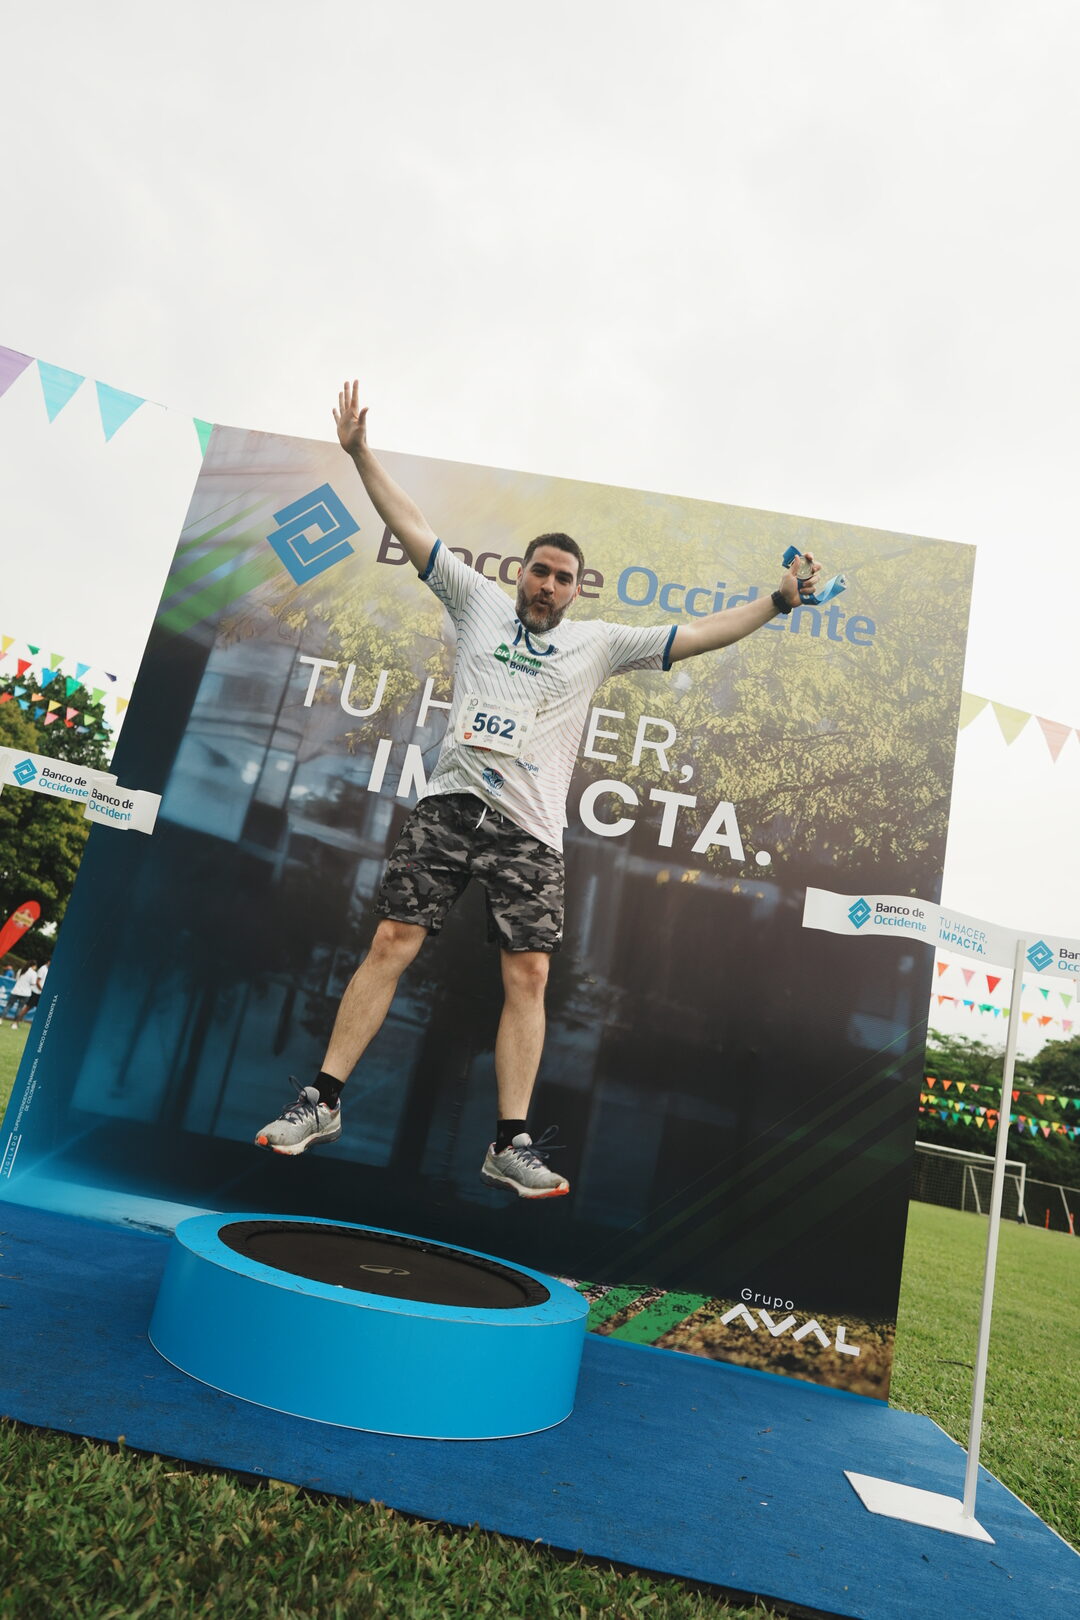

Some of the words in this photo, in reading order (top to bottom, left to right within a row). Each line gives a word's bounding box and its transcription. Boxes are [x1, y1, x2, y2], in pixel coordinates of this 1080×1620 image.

[300, 655, 389, 717] TU
[472, 712, 516, 740] 562
[38, 778, 89, 797] Occidente
[42, 767, 73, 783] Banco
[74, 776, 87, 787] de
[91, 788, 121, 807] Banco
[122, 799, 134, 810] de
[876, 902, 910, 916] Banco
[912, 908, 925, 919] de
[874, 914, 927, 932] Occidente
[940, 916, 951, 929] TU
[938, 928, 986, 955] IMPACTA.
[2, 1135, 18, 1176] VIGILADO
[741, 1288, 794, 1310] Grupo
[720, 1303, 860, 1357] AVAL
